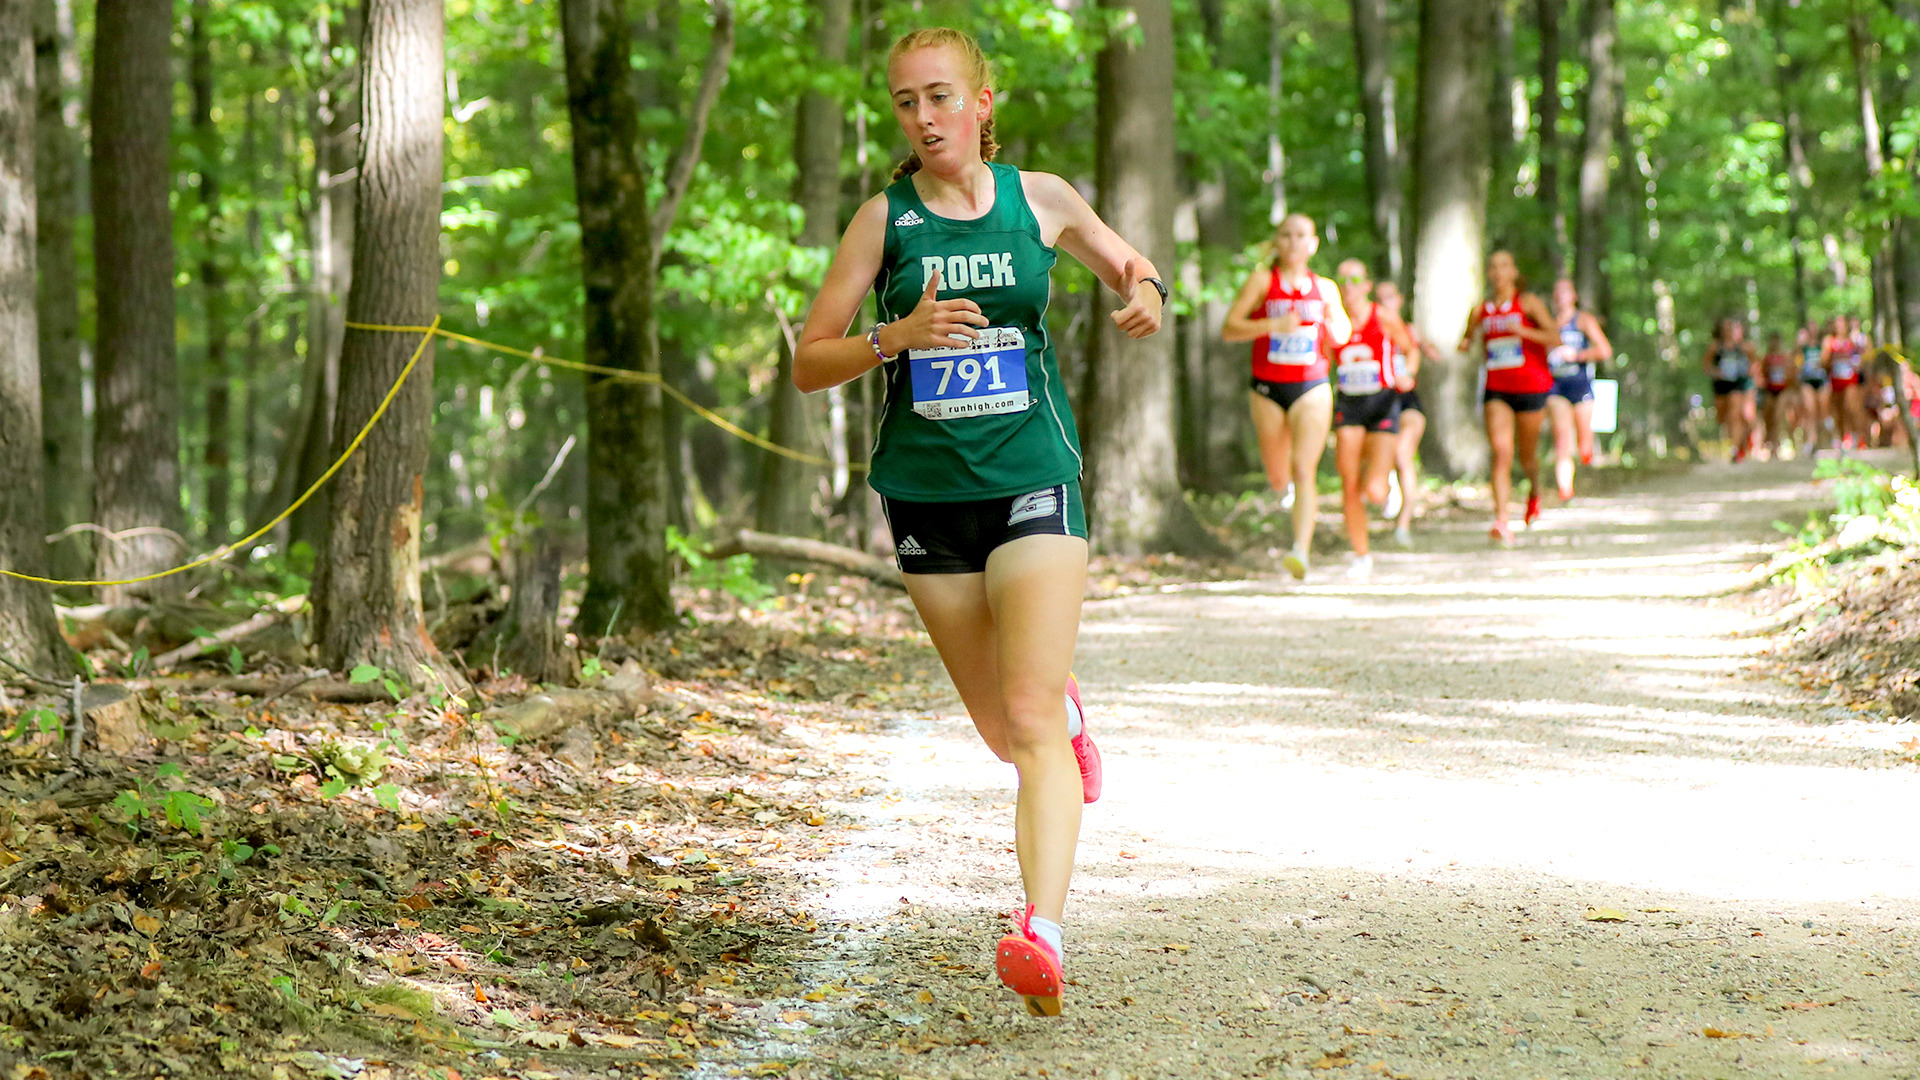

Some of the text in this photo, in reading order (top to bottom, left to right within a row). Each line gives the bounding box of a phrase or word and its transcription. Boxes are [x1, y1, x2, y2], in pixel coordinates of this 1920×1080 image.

[894, 217, 925, 227] adidas
[921, 252, 1016, 292] ROCK
[930, 355, 1007, 396] 791
[948, 399, 1015, 413] runhigh.com
[898, 547, 928, 556] adidas
